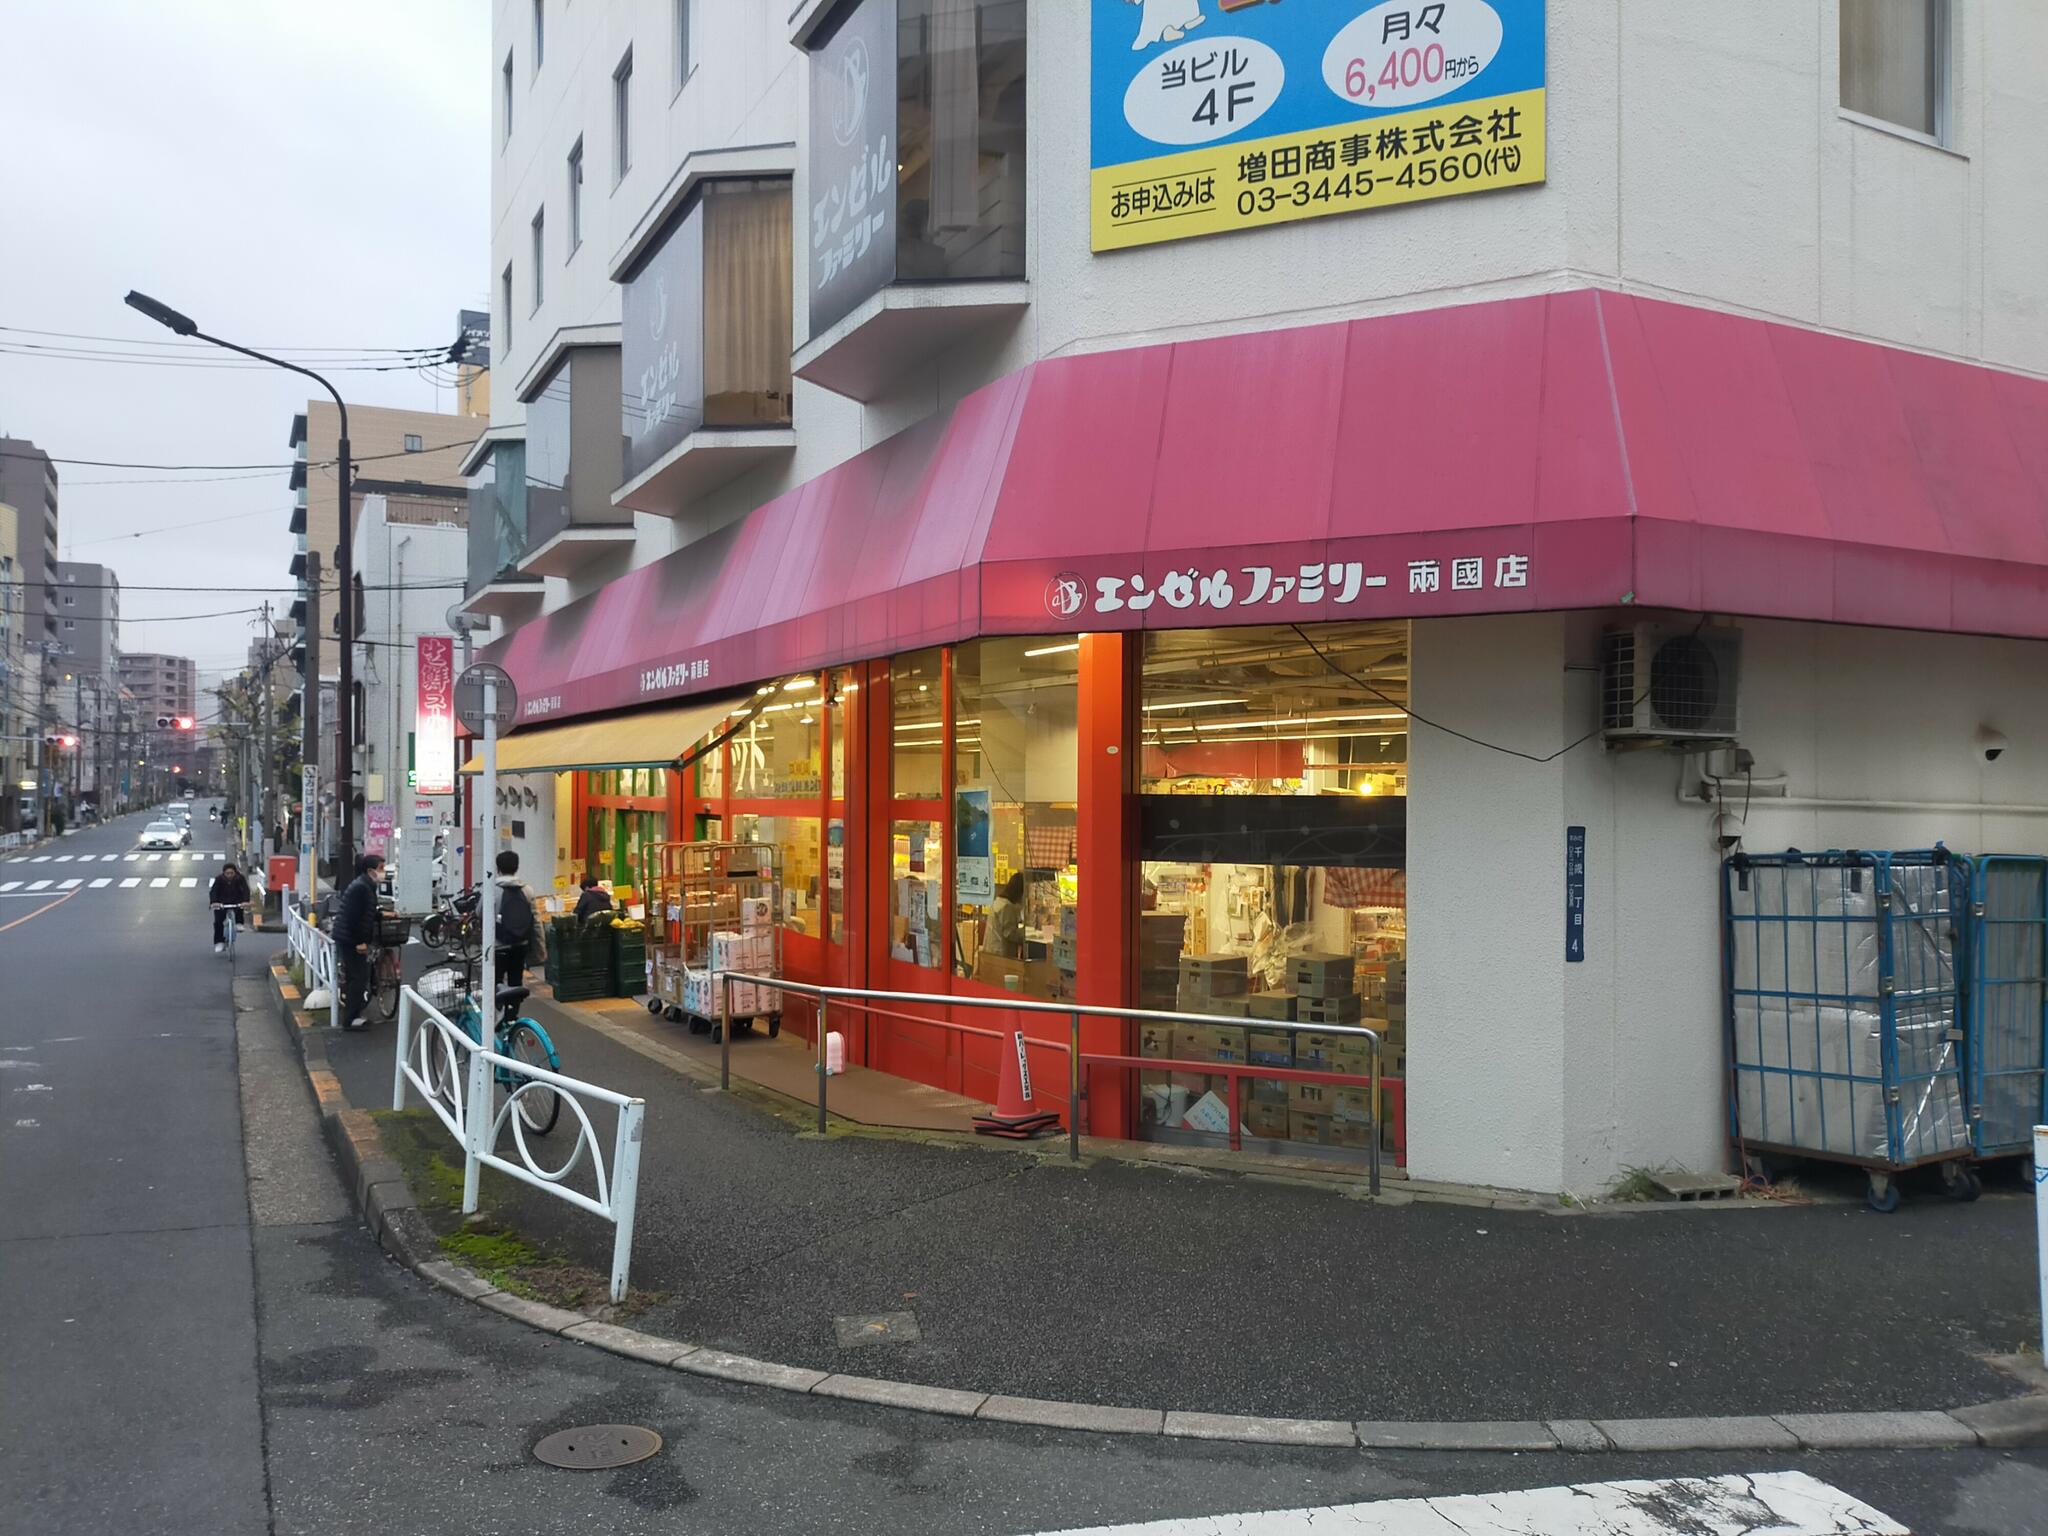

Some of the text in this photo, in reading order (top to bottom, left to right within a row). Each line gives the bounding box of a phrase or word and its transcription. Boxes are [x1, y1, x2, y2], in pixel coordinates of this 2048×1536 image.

[1382, 3, 1445, 44] 月々
[1161, 48, 1249, 90] 当ビル
[1344, 42, 1480, 101] 6,400円から
[1191, 81, 1256, 126] 4F
[1237, 106, 1522, 184] 増田商事株式会社
[1111, 176, 1216, 219] お申込みは
[1237, 145, 1522, 216] 03-3445-4560(代)
[1094, 566, 1388, 613] エンゼルファミリー
[1571, 938, 1579, 952] 4
